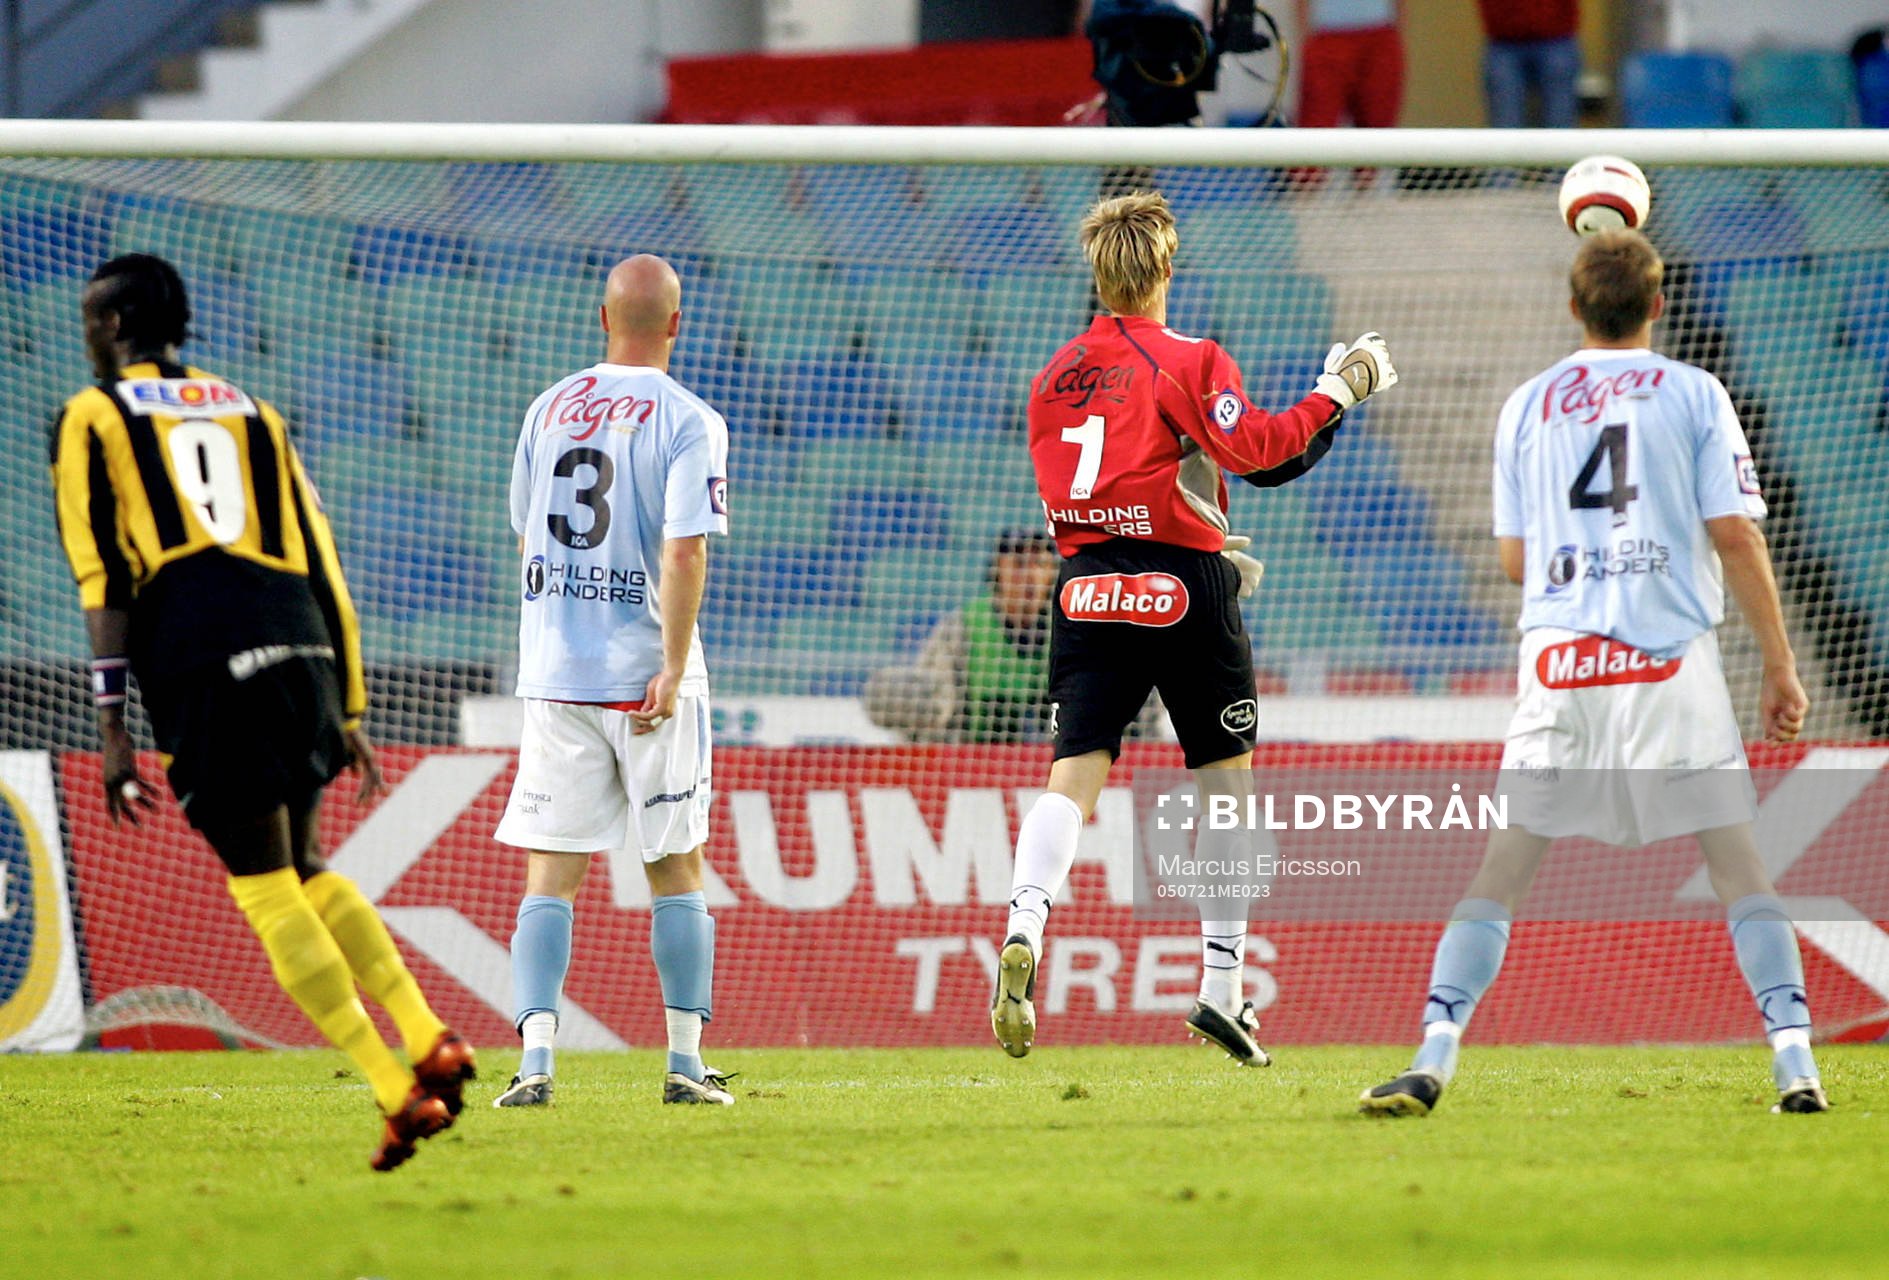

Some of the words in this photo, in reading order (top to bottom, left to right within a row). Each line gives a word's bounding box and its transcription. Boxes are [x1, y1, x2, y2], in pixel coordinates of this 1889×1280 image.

[133, 382, 240, 406] ELON
[543, 376, 655, 441] Pågen
[1219, 399, 1235, 422] 13
[1061, 414, 1105, 499] 1
[167, 420, 246, 545] 9
[1569, 422, 1638, 528] 4
[547, 447, 614, 550] 3
[1050, 505, 1150, 524] HILDING
[1105, 521, 1153, 536] ERS
[549, 562, 646, 586] HILDING
[547, 582, 644, 605] ANDERS
[1069, 580, 1174, 614] Malaco
